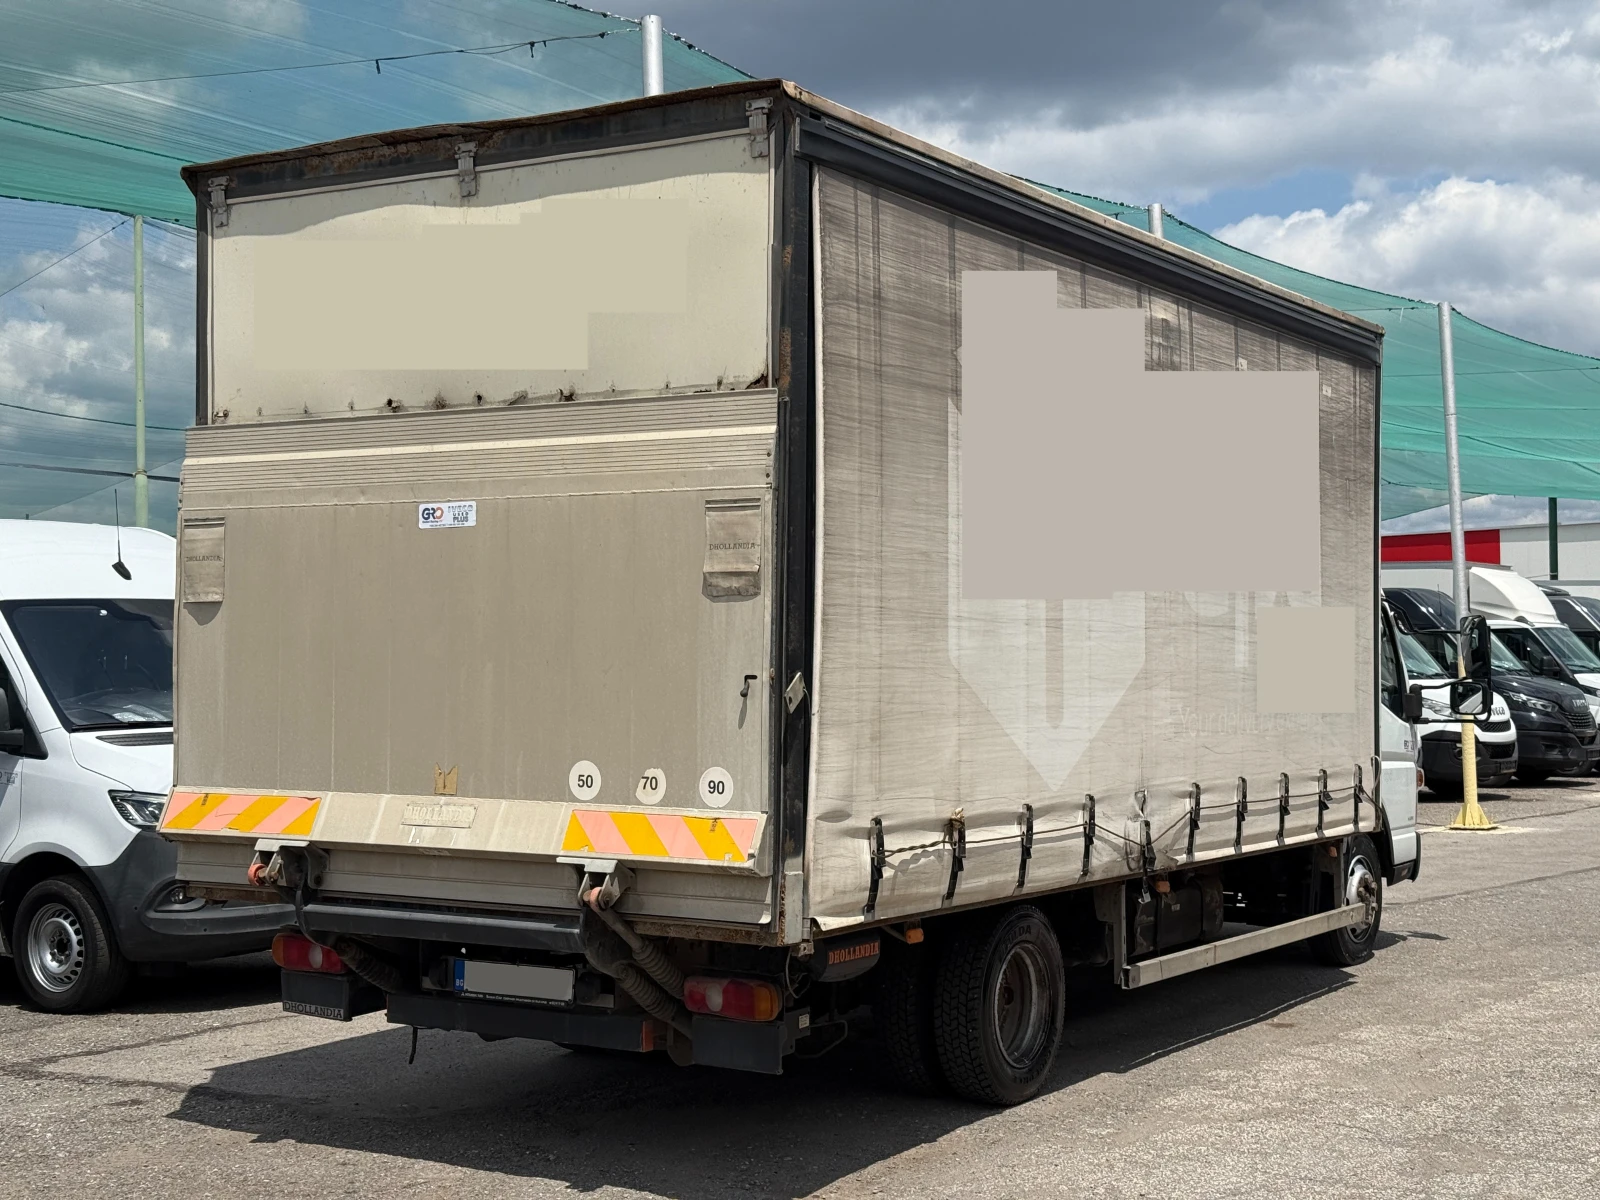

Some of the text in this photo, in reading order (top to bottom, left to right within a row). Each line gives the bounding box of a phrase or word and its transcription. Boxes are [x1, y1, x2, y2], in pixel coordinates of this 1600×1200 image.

[447, 505, 473, 513] IVECO
[709, 543, 756, 551] DHOLLANDIA
[577, 774, 594, 788] 50
[641, 776, 658, 790] 70
[707, 780, 725, 795] 90
[828, 942, 879, 965] DHOLLANDIA
[455, 978, 464, 987] BG
[284, 1002, 344, 1019] DHOLLANDIA
